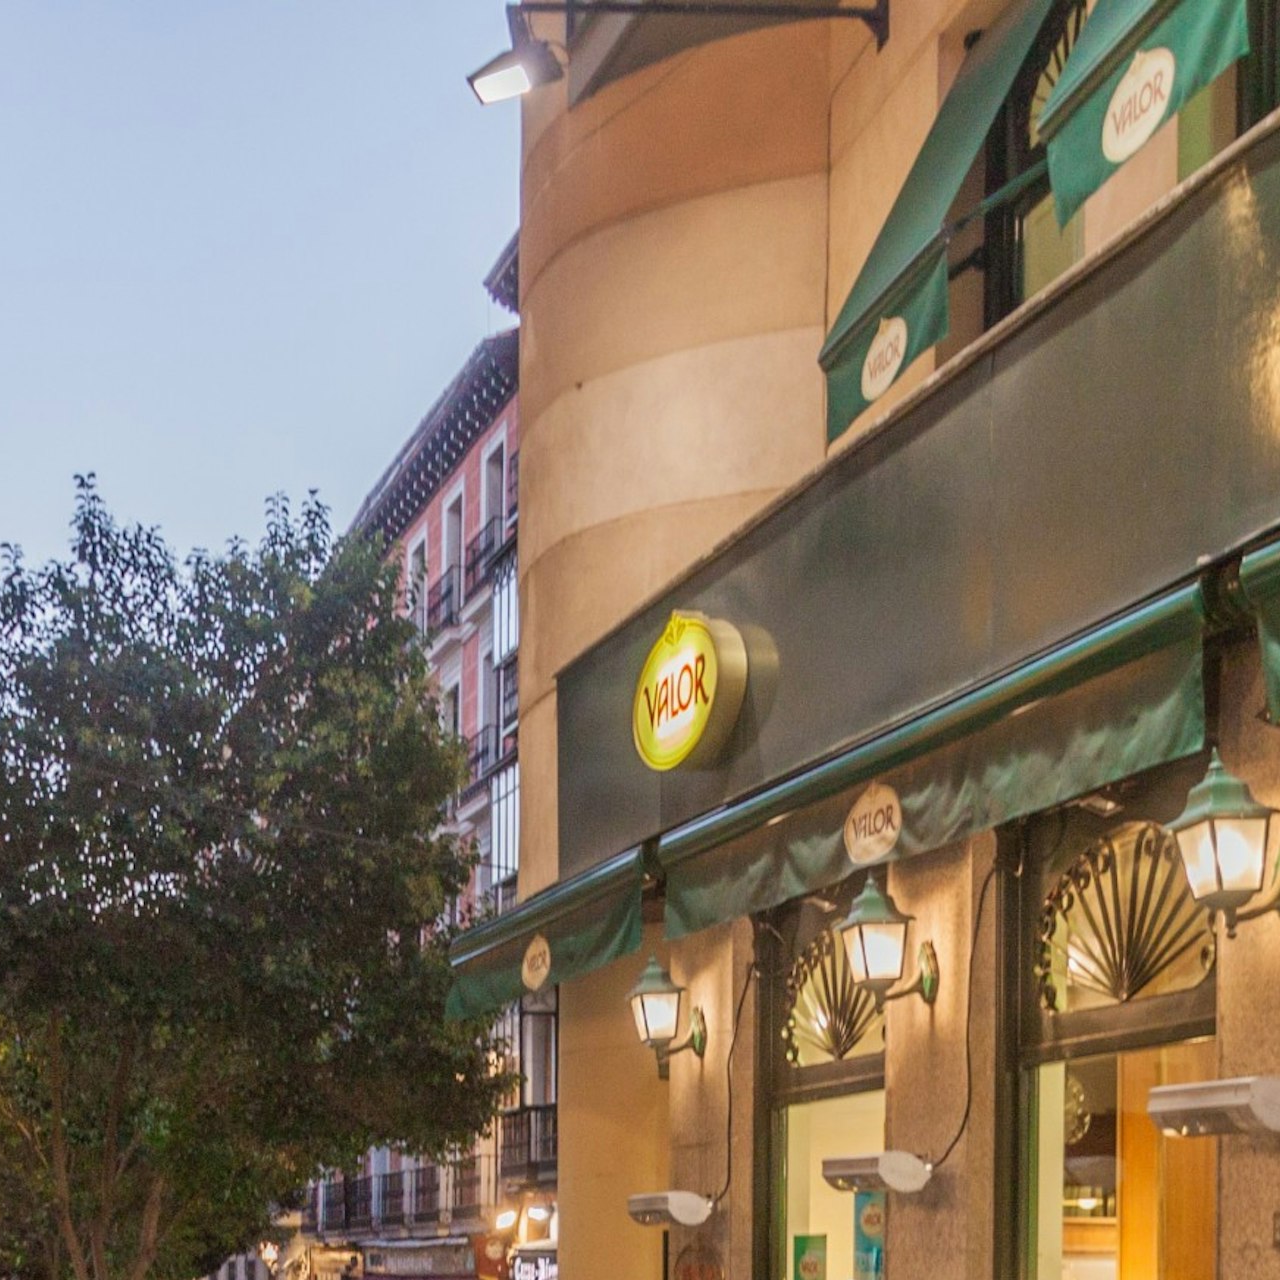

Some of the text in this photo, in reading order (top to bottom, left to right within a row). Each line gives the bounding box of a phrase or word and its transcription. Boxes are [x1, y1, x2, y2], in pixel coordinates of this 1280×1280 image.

[1111, 71, 1166, 138] VALOR
[867, 334, 902, 383] VALOR
[644, 653, 710, 733] VALOR
[852, 803, 896, 840] VALOR
